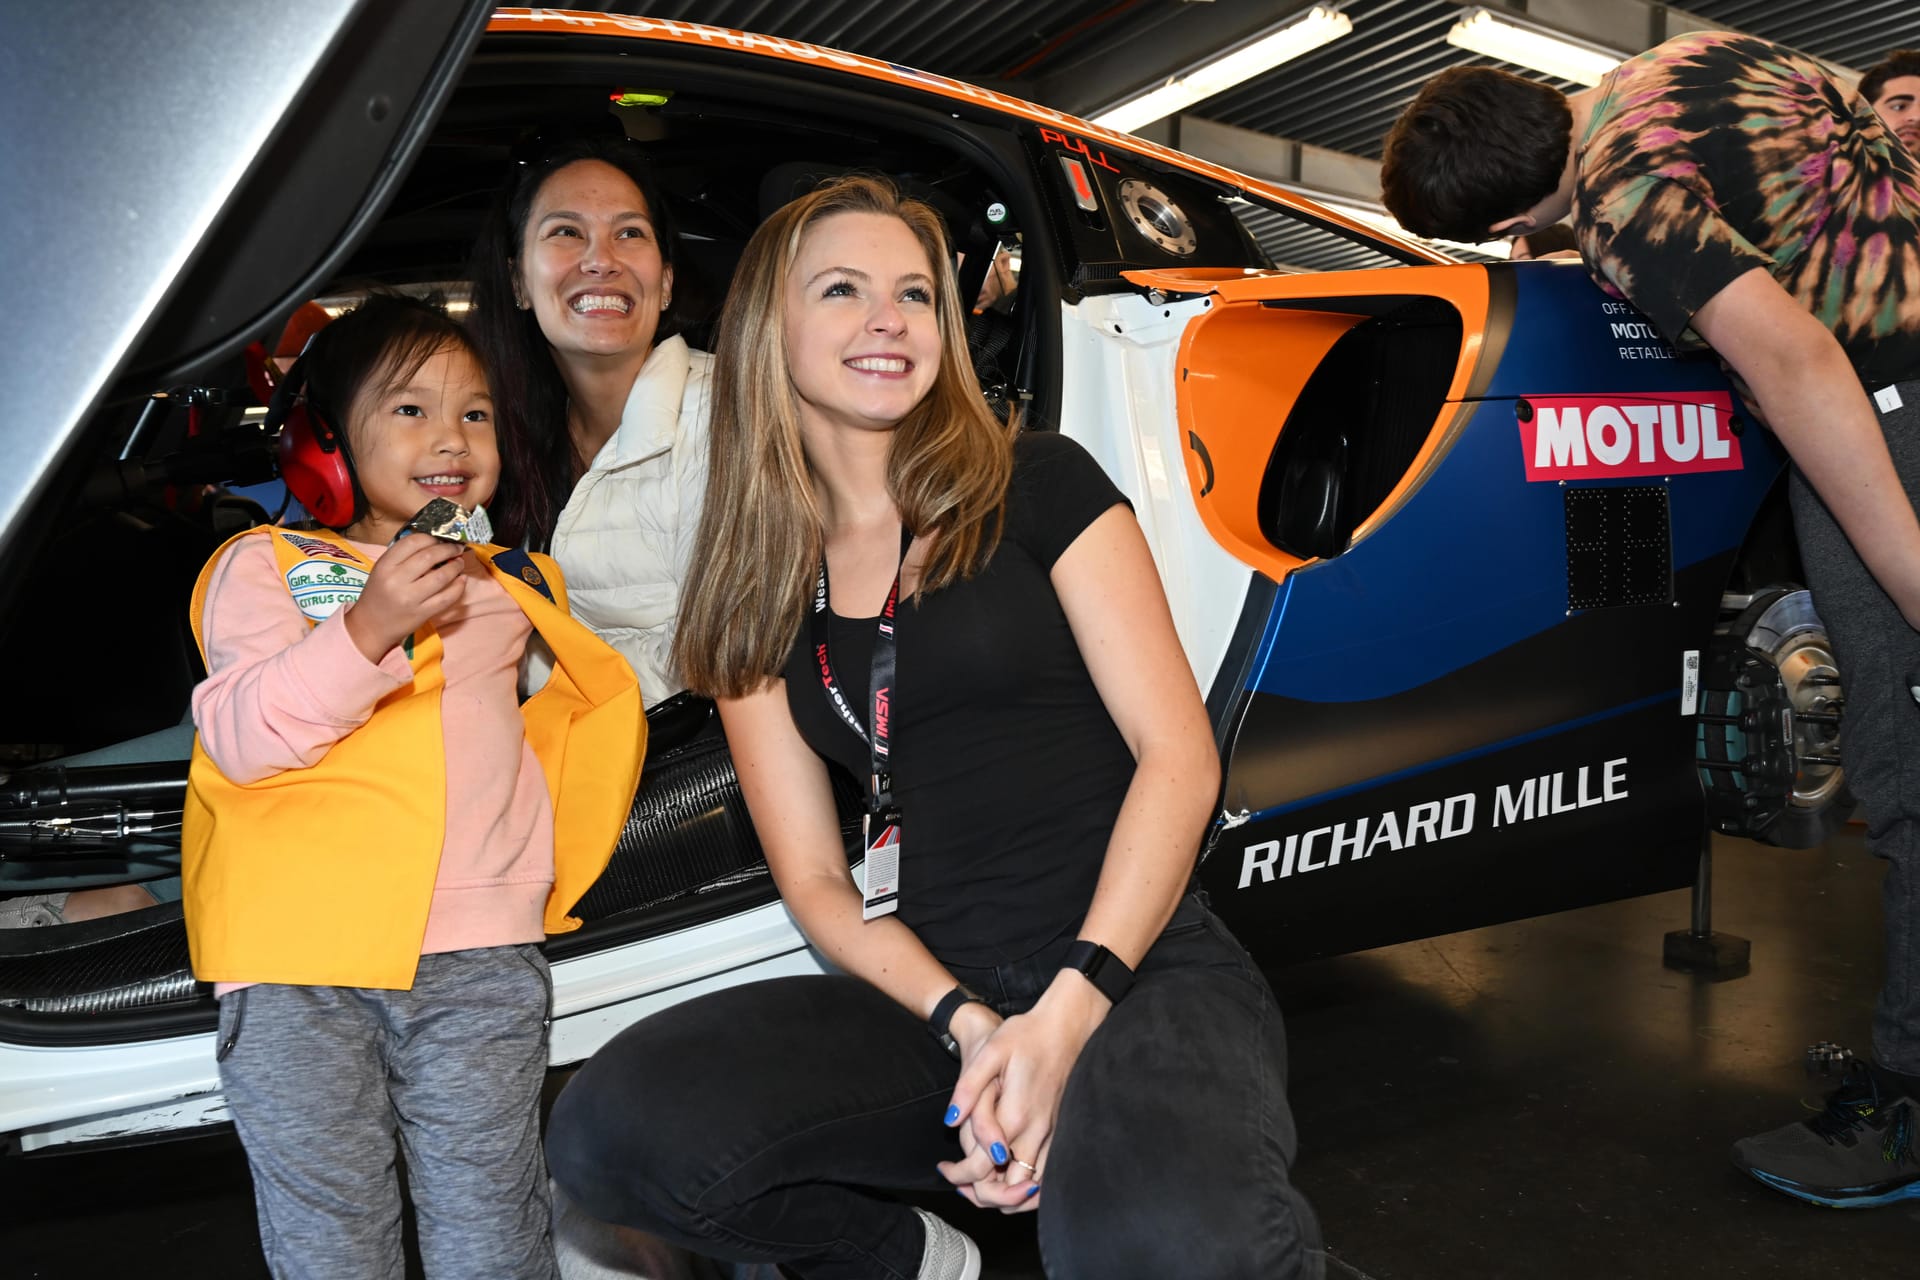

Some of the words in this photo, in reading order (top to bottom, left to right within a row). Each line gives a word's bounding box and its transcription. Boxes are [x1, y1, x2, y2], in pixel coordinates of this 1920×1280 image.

[1039, 128, 1120, 174] PULL
[1534, 404, 1730, 468] MOTUL
[290, 575, 315, 587] GIRL
[316, 574, 364, 586] SCOUTS
[299, 594, 335, 608] CITRUS
[875, 687, 889, 738] IMSA
[1237, 792, 1477, 890] RICHARD
[1493, 757, 1629, 828] MILLE
